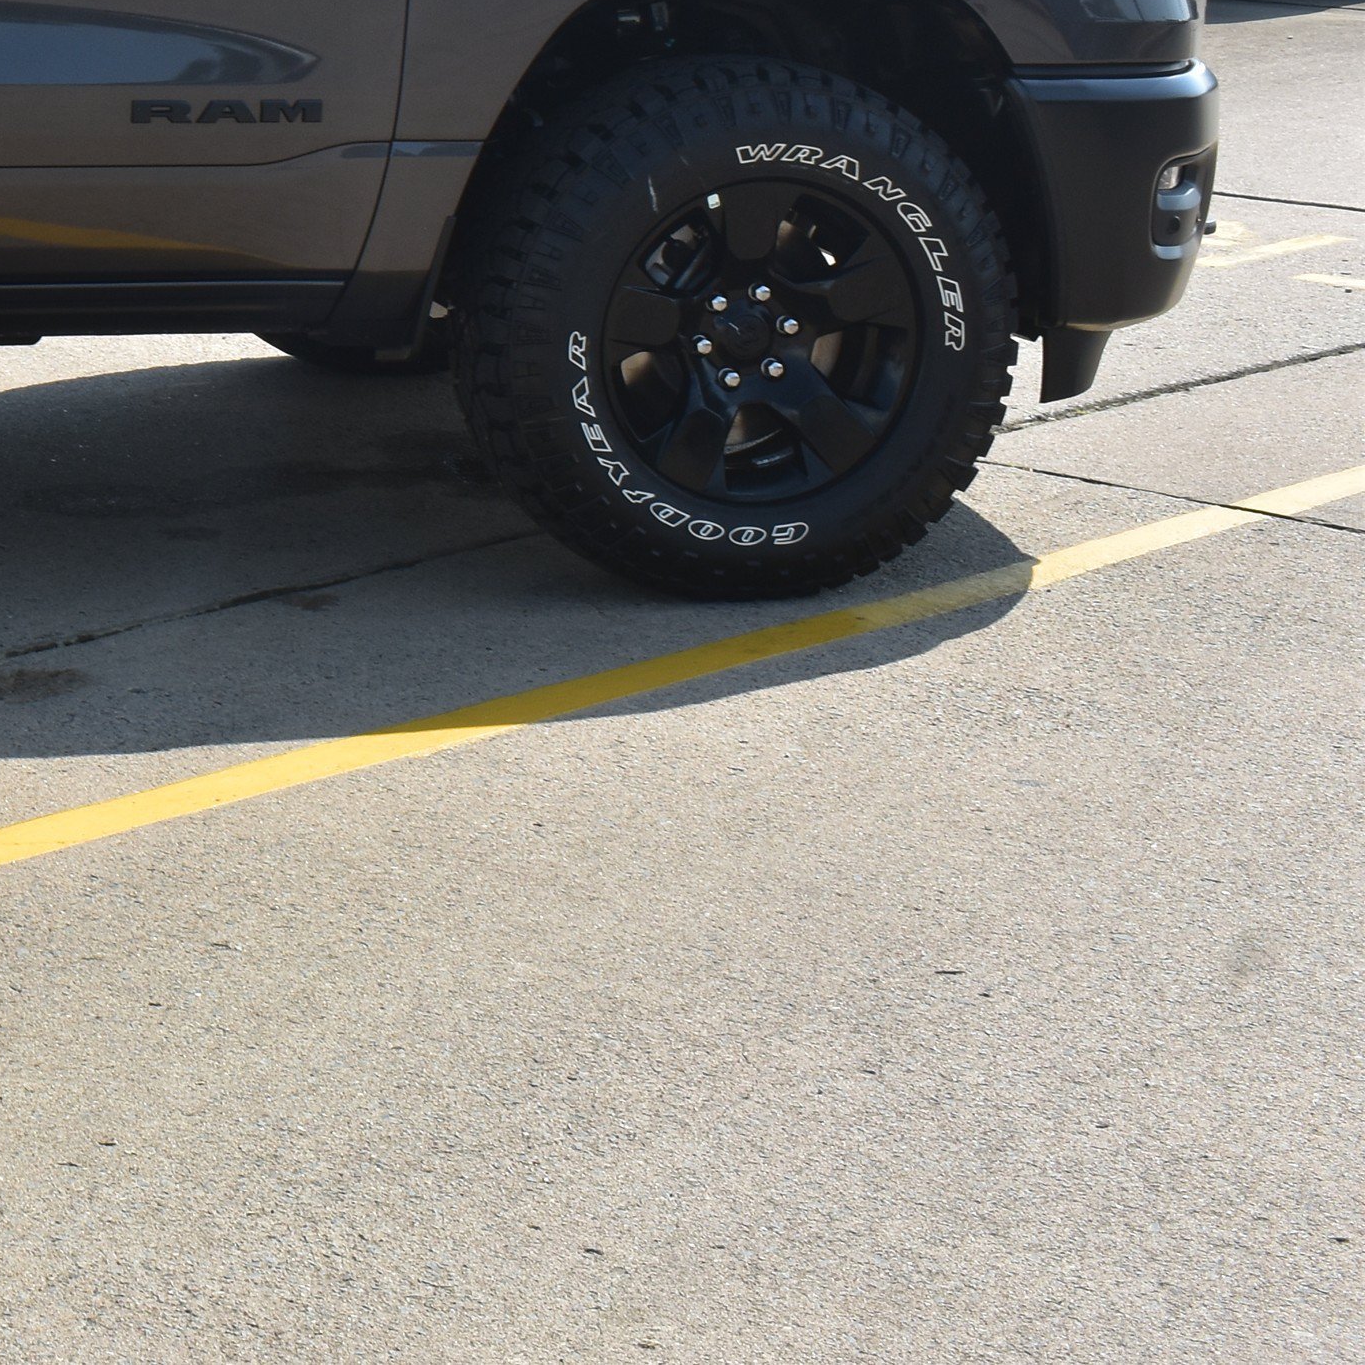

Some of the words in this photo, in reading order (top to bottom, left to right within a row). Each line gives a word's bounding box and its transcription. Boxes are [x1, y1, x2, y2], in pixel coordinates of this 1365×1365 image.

[130, 98, 323, 124] RAM
[735, 142, 966, 352] WRANGLER
[570, 330, 809, 546] GOODYEAR
